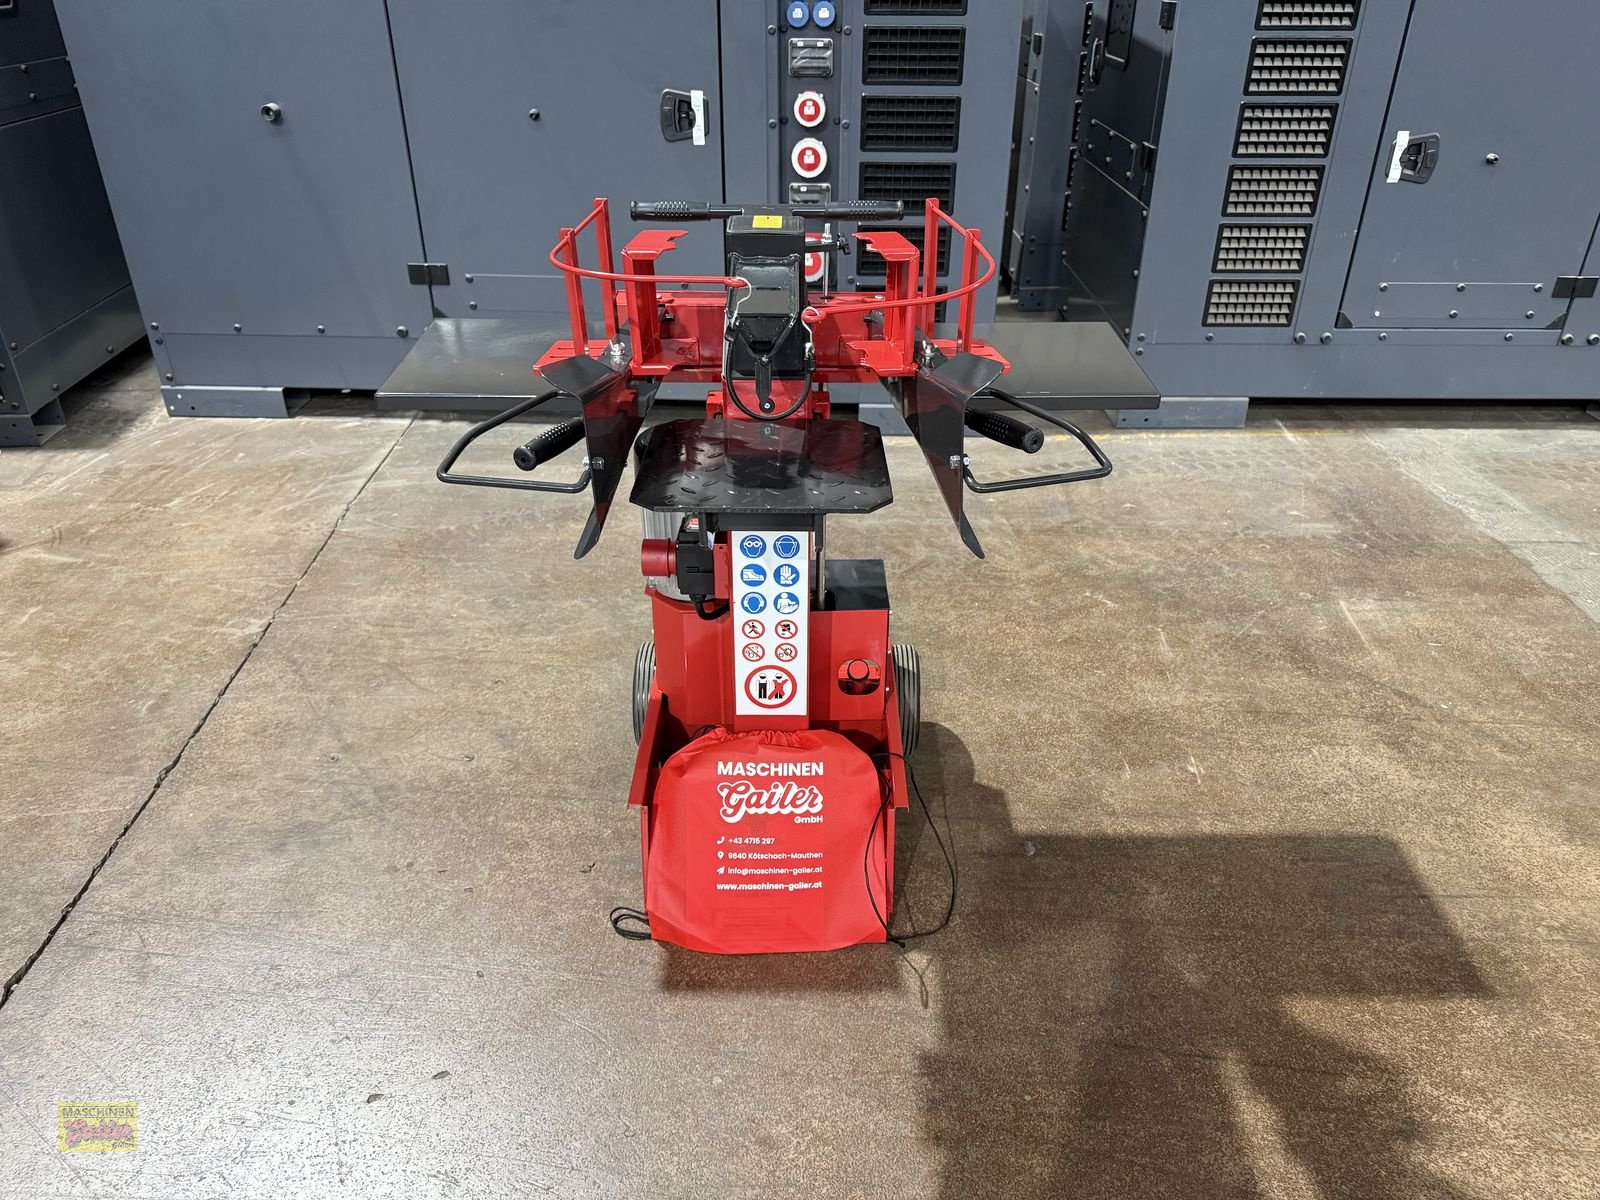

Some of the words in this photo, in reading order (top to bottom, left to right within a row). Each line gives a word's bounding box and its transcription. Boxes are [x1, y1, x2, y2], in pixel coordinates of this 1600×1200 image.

[717, 760, 824, 777] MASCHINEN
[717, 780, 824, 824] Gailer
[794, 815, 824, 824] GmbH
[728, 837, 743, 845] +43
[728, 865, 823, 876] info@maschinen-gailer.at
[717, 880, 823, 892] www.maschinen-gailer.at
